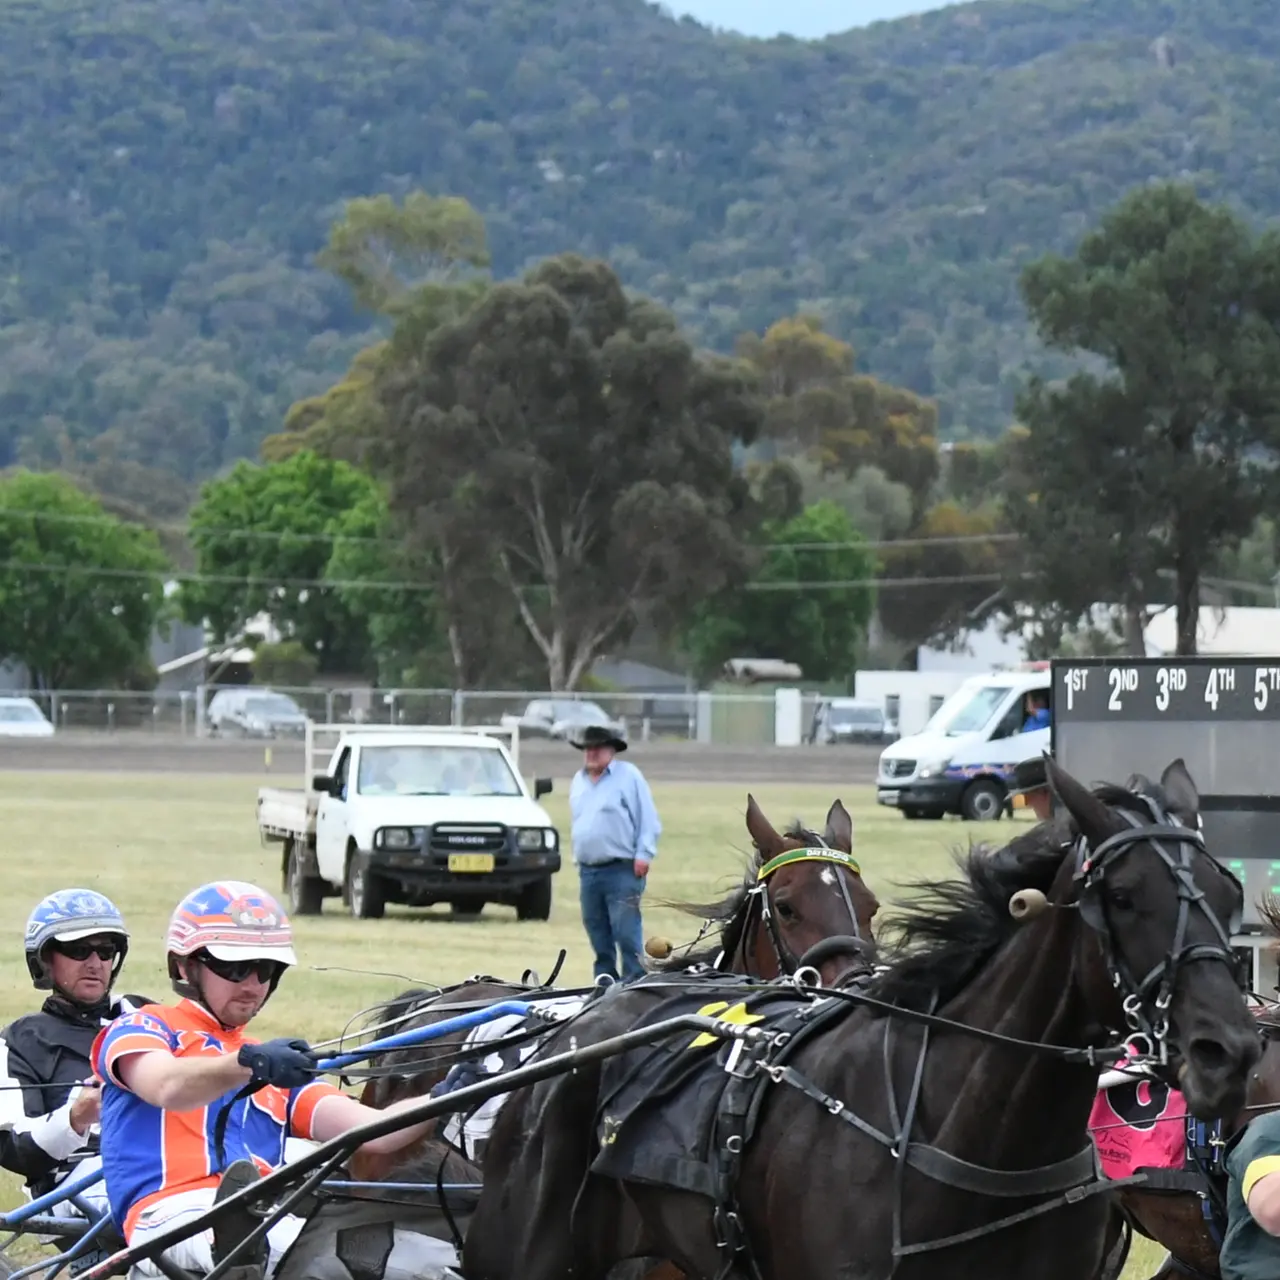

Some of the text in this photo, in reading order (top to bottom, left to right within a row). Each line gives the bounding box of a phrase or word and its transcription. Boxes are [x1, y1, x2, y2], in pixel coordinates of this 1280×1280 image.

[1063, 668, 1088, 710] 1ST
[1108, 668, 1138, 711] 2ND
[1156, 668, 1187, 711] 3RD
[1204, 668, 1235, 711] 4TH
